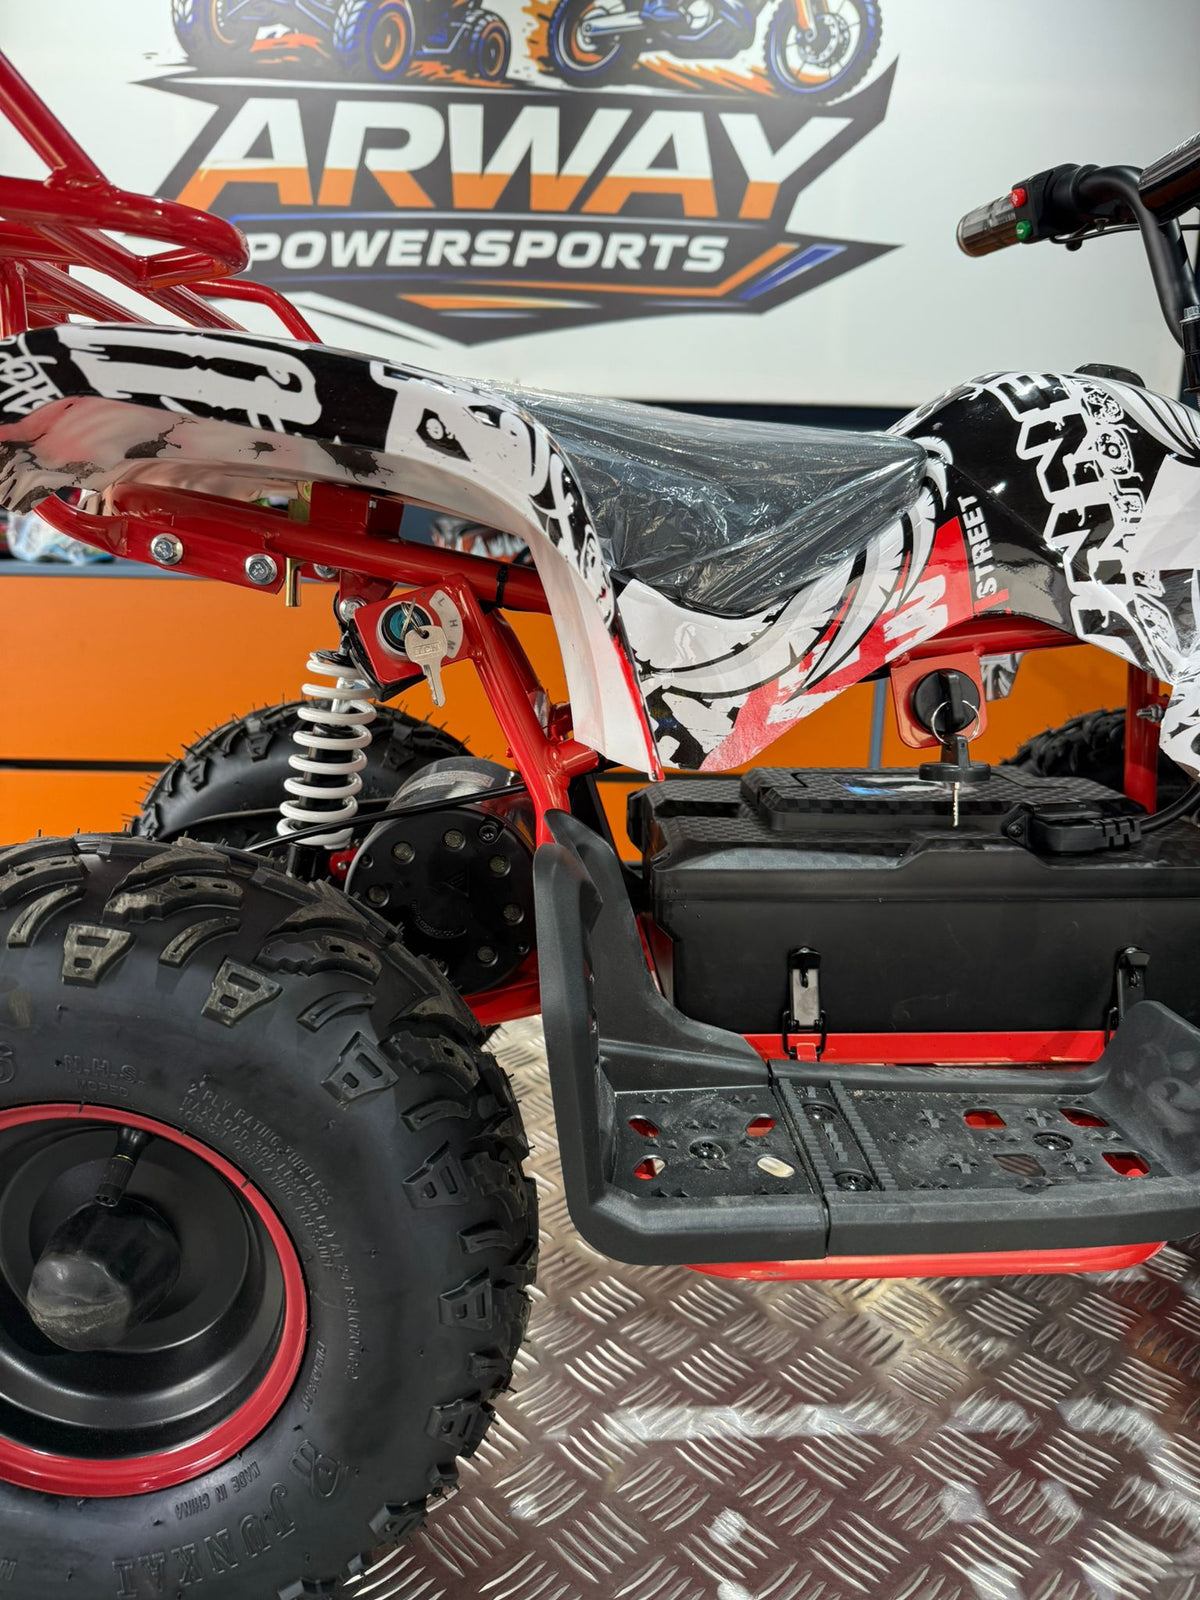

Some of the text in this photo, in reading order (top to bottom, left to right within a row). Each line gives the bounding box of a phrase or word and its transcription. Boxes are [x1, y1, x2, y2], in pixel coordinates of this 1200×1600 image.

[174, 97, 855, 220] ARWAY
[244, 229, 730, 274] POWERSPORTS
[957, 494, 998, 600] STREET
[203, 1089, 231, 1110] PLY
